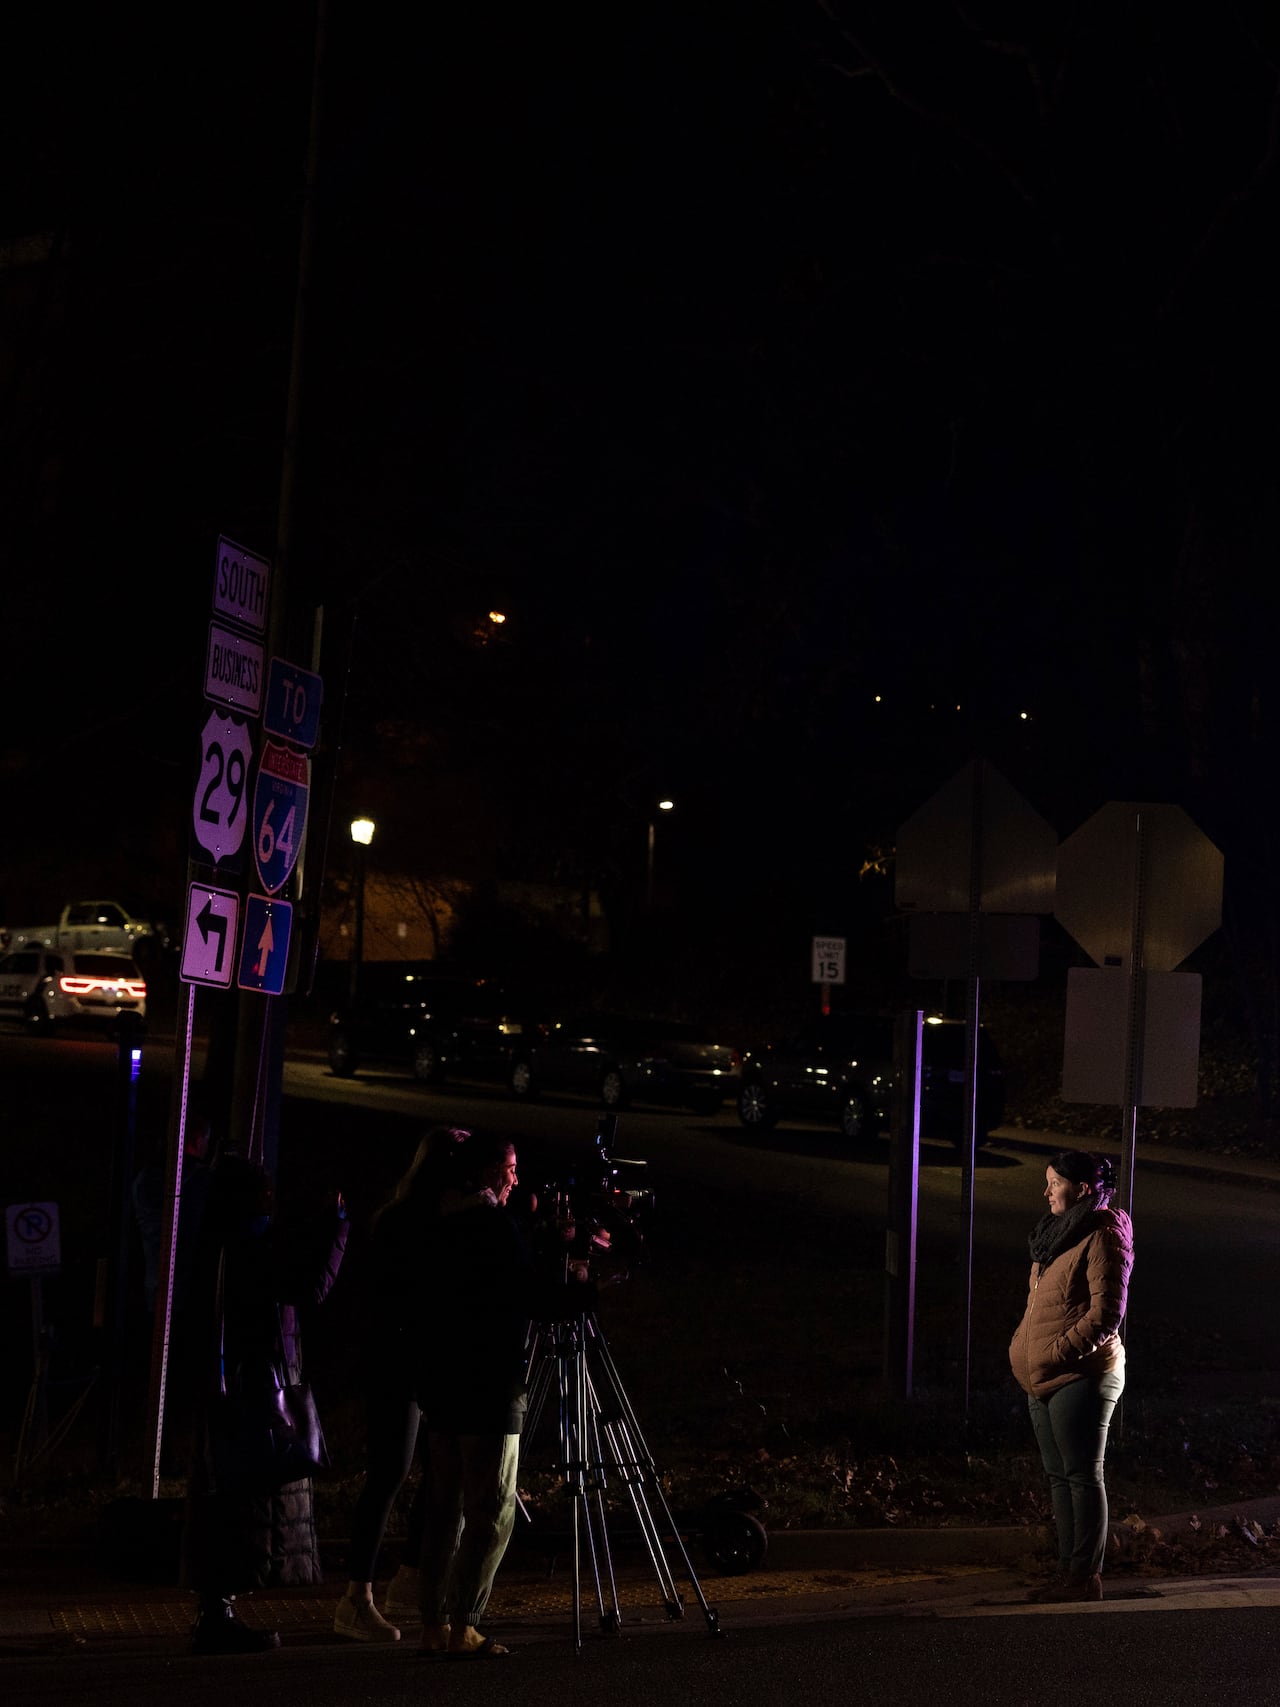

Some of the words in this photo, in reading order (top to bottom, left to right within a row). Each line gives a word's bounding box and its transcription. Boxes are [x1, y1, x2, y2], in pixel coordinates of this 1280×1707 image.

[219, 556, 267, 616] SOUTH
[212, 644, 260, 694] BUSINESS
[282, 678, 307, 725] TO
[200, 741, 244, 828] 29
[258, 799, 298, 870] 64
[819, 961, 839, 979] 15
